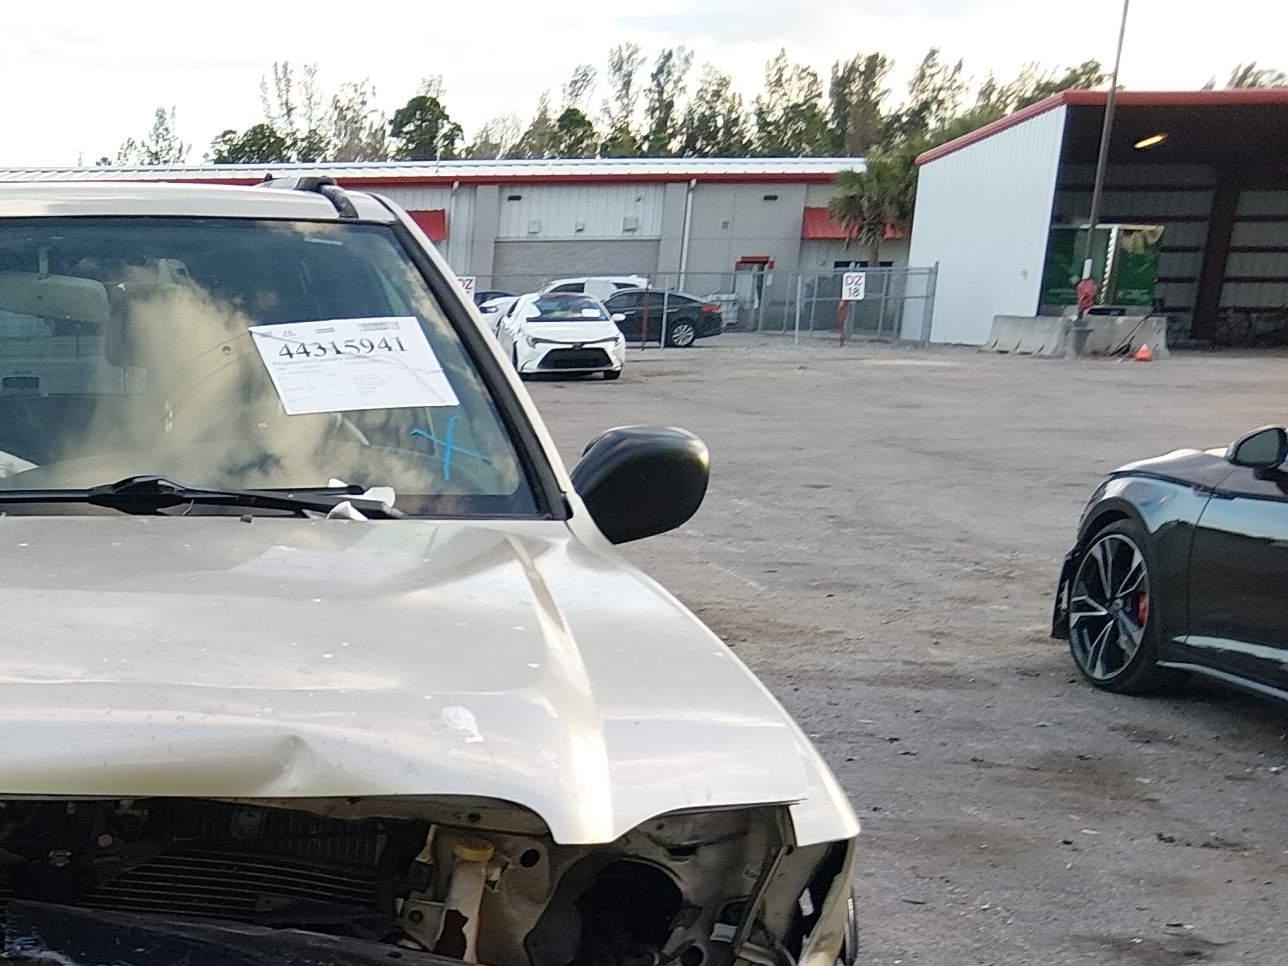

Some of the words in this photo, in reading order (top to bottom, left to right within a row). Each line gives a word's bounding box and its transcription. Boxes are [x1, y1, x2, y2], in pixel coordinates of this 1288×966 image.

[845, 275, 863, 286] DZ
[848, 286, 860, 298] 18
[278, 336, 408, 359] 44315941
